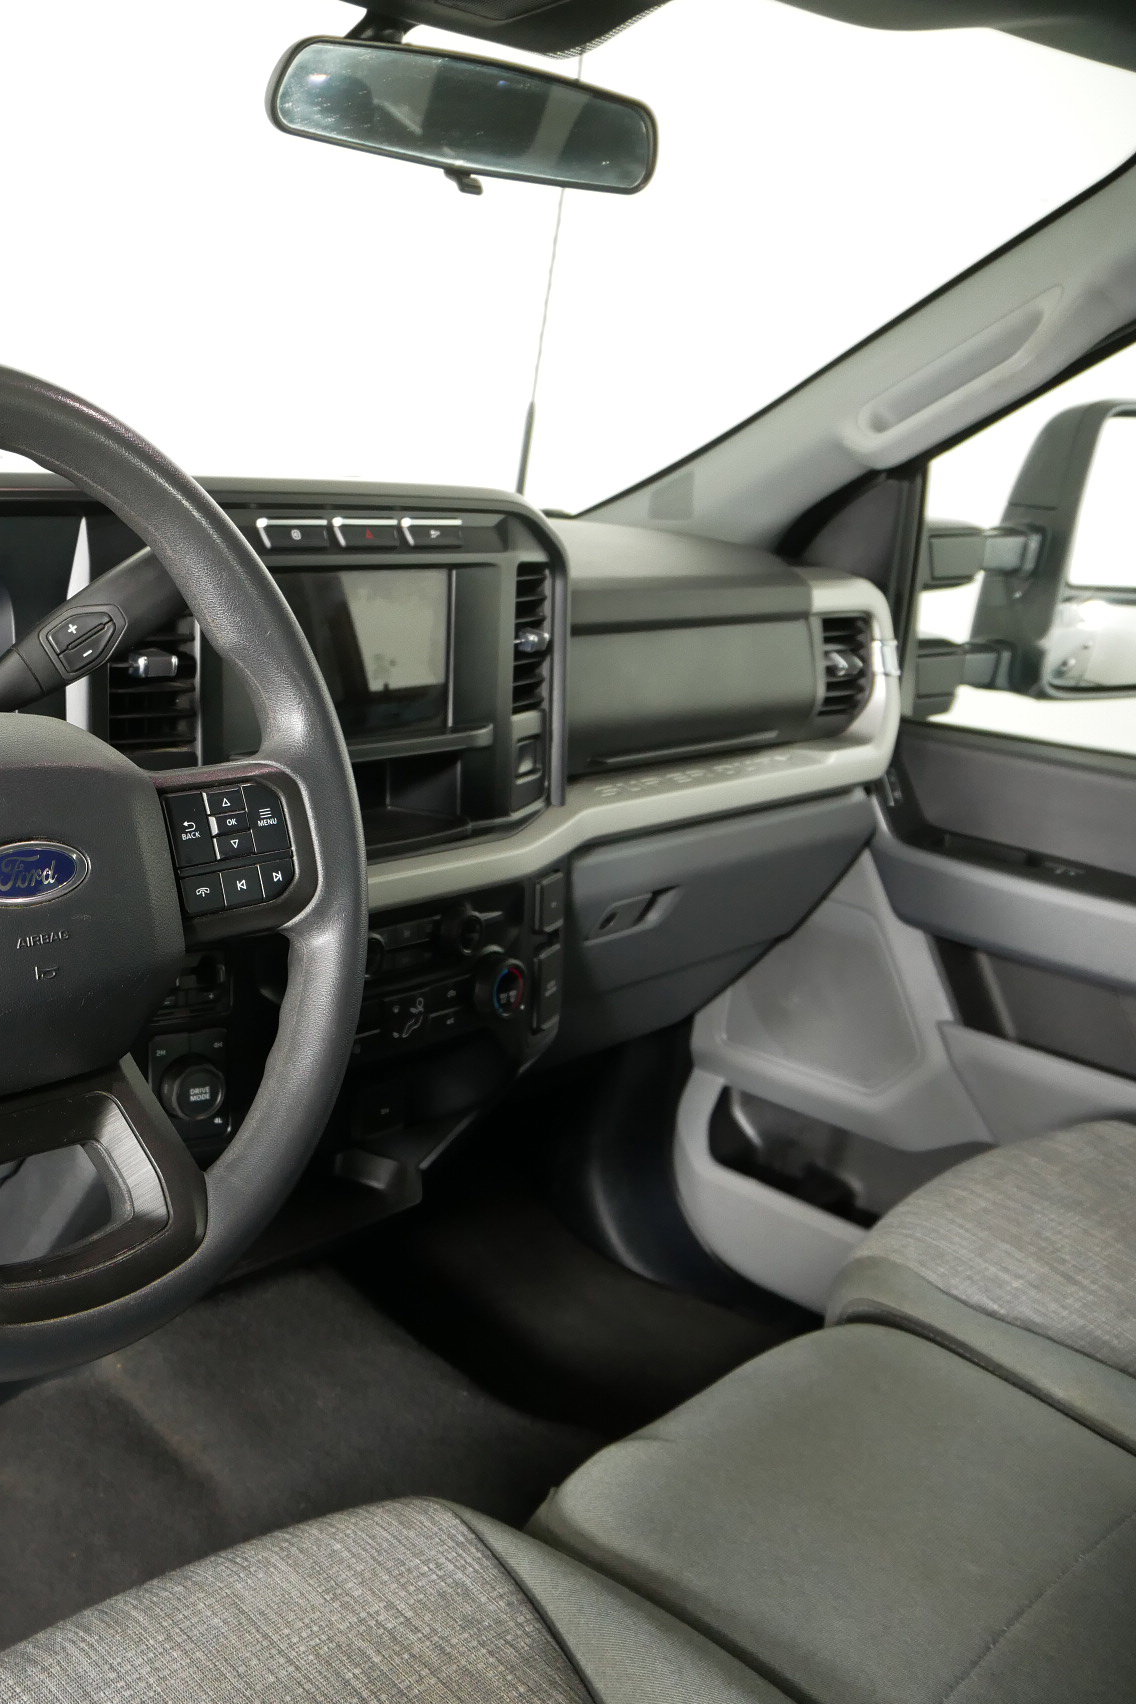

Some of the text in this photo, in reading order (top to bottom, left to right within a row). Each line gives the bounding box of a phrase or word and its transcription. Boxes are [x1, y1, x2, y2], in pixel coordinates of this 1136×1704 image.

[226, 817, 238, 826] OK
[257, 816, 278, 827] MENU
[181, 830, 202, 841] BACK
[16, 929, 70, 950] AIRBAG
[190, 1086, 209, 1095] DRIVE
[189, 1093, 210, 1101] MODE
